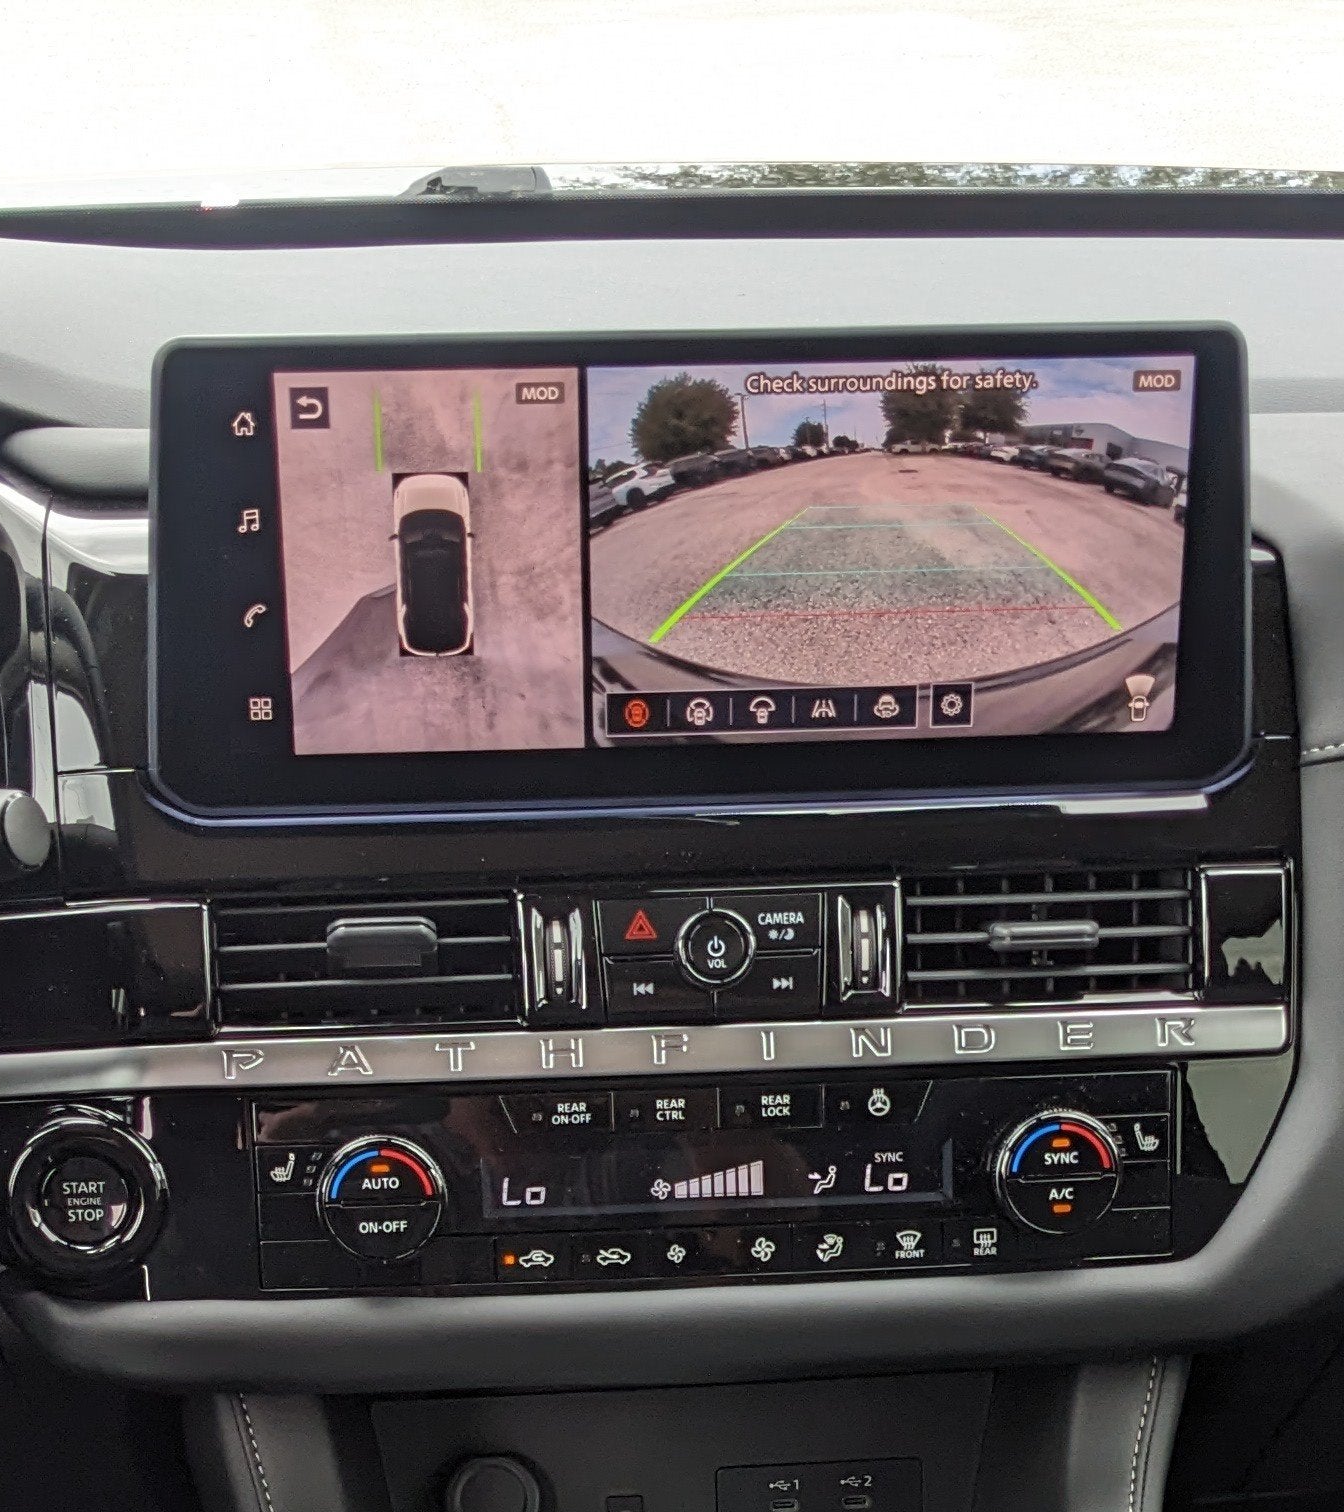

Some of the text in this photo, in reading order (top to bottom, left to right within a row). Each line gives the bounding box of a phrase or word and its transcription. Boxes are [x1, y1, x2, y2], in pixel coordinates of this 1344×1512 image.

[746, 371, 1038, 396] Check surroundings for safety.
[1138, 374, 1175, 388] MOD
[521, 386, 559, 400] MOD
[757, 911, 805, 926] CAMERA
[707, 958, 727, 969] VOL
[221, 1017, 1195, 1080] PATHFINDER
[656, 1098, 686, 1109] REAR
[761, 1094, 791, 1105] REAR
[557, 1102, 587, 1113] REAR
[761, 1106, 791, 1117] LOCK
[656, 1110, 686, 1121] CTRL
[874, 1152, 904, 1163] SYNC
[1043, 1151, 1079, 1165] SYNC
[62, 1181, 106, 1194] START
[361, 1177, 400, 1190] AUTO
[1048, 1187, 1074, 1200] A/C
[67, 1196, 102, 1206] ENGINE
[67, 1209, 104, 1222] STOP
[895, 1249, 925, 1259] FRONT
[973, 1246, 997, 1256] REAR
[863, 1475, 872, 1487] 2
